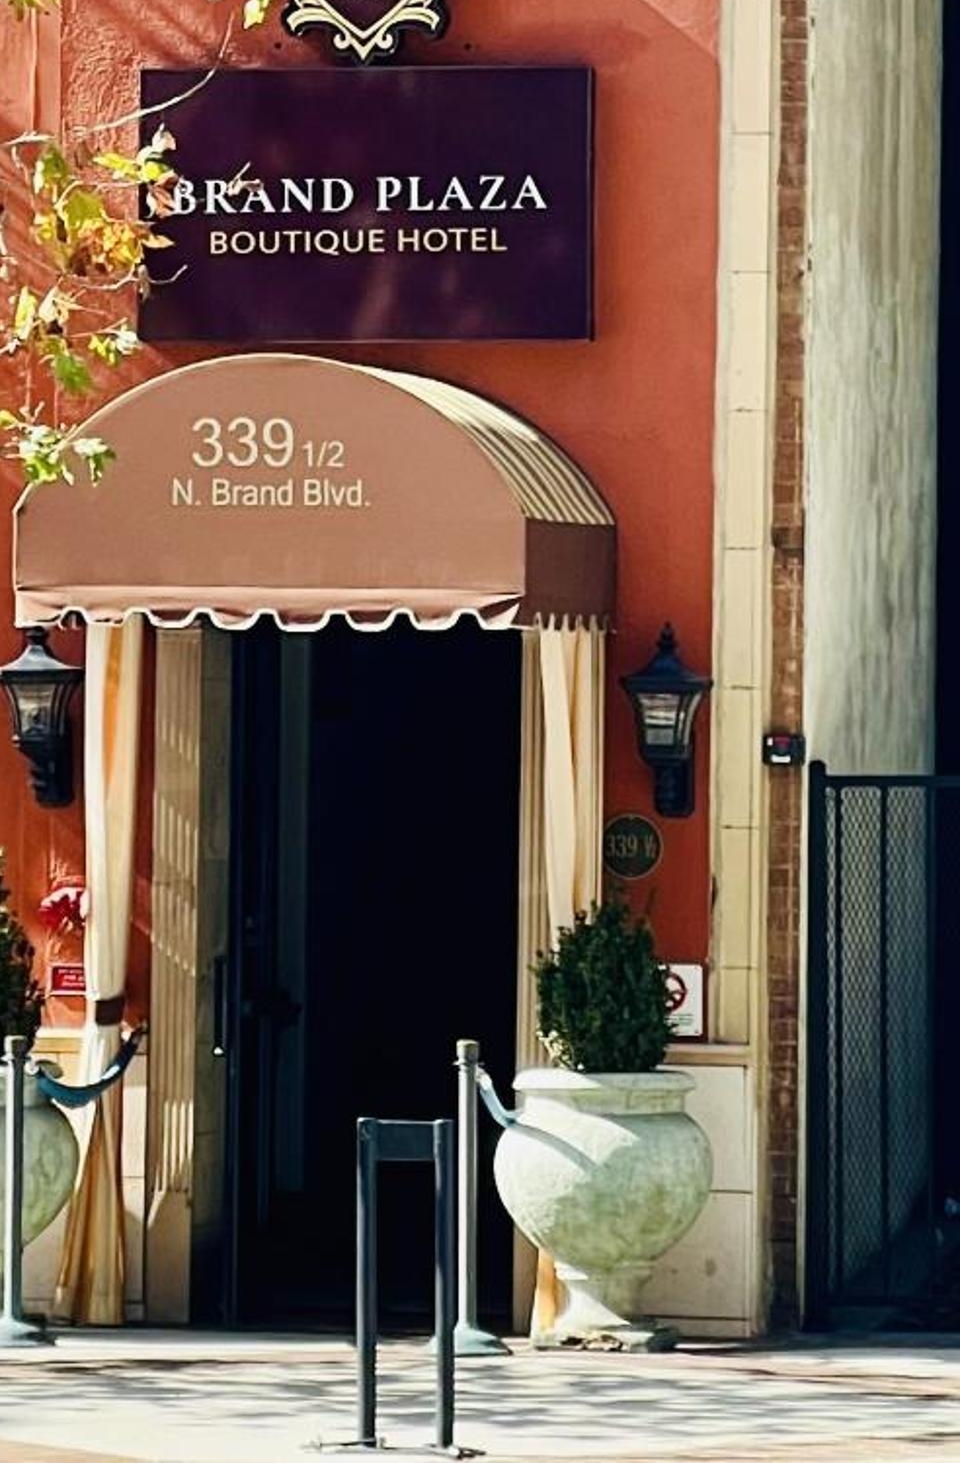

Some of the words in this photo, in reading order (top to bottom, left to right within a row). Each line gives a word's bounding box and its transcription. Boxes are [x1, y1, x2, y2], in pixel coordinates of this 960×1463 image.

[171, 177, 355, 216] BRAND
[377, 175, 548, 211] PLAZA
[209, 229, 385, 256] BOUTIQUE
[397, 226, 508, 253] HOTEL
[191, 417, 294, 468] 339
[302, 440, 345, 468] 1/2
[171, 478, 202, 506] N.
[211, 478, 294, 506] Brand
[303, 478, 372, 506] Blvd.
